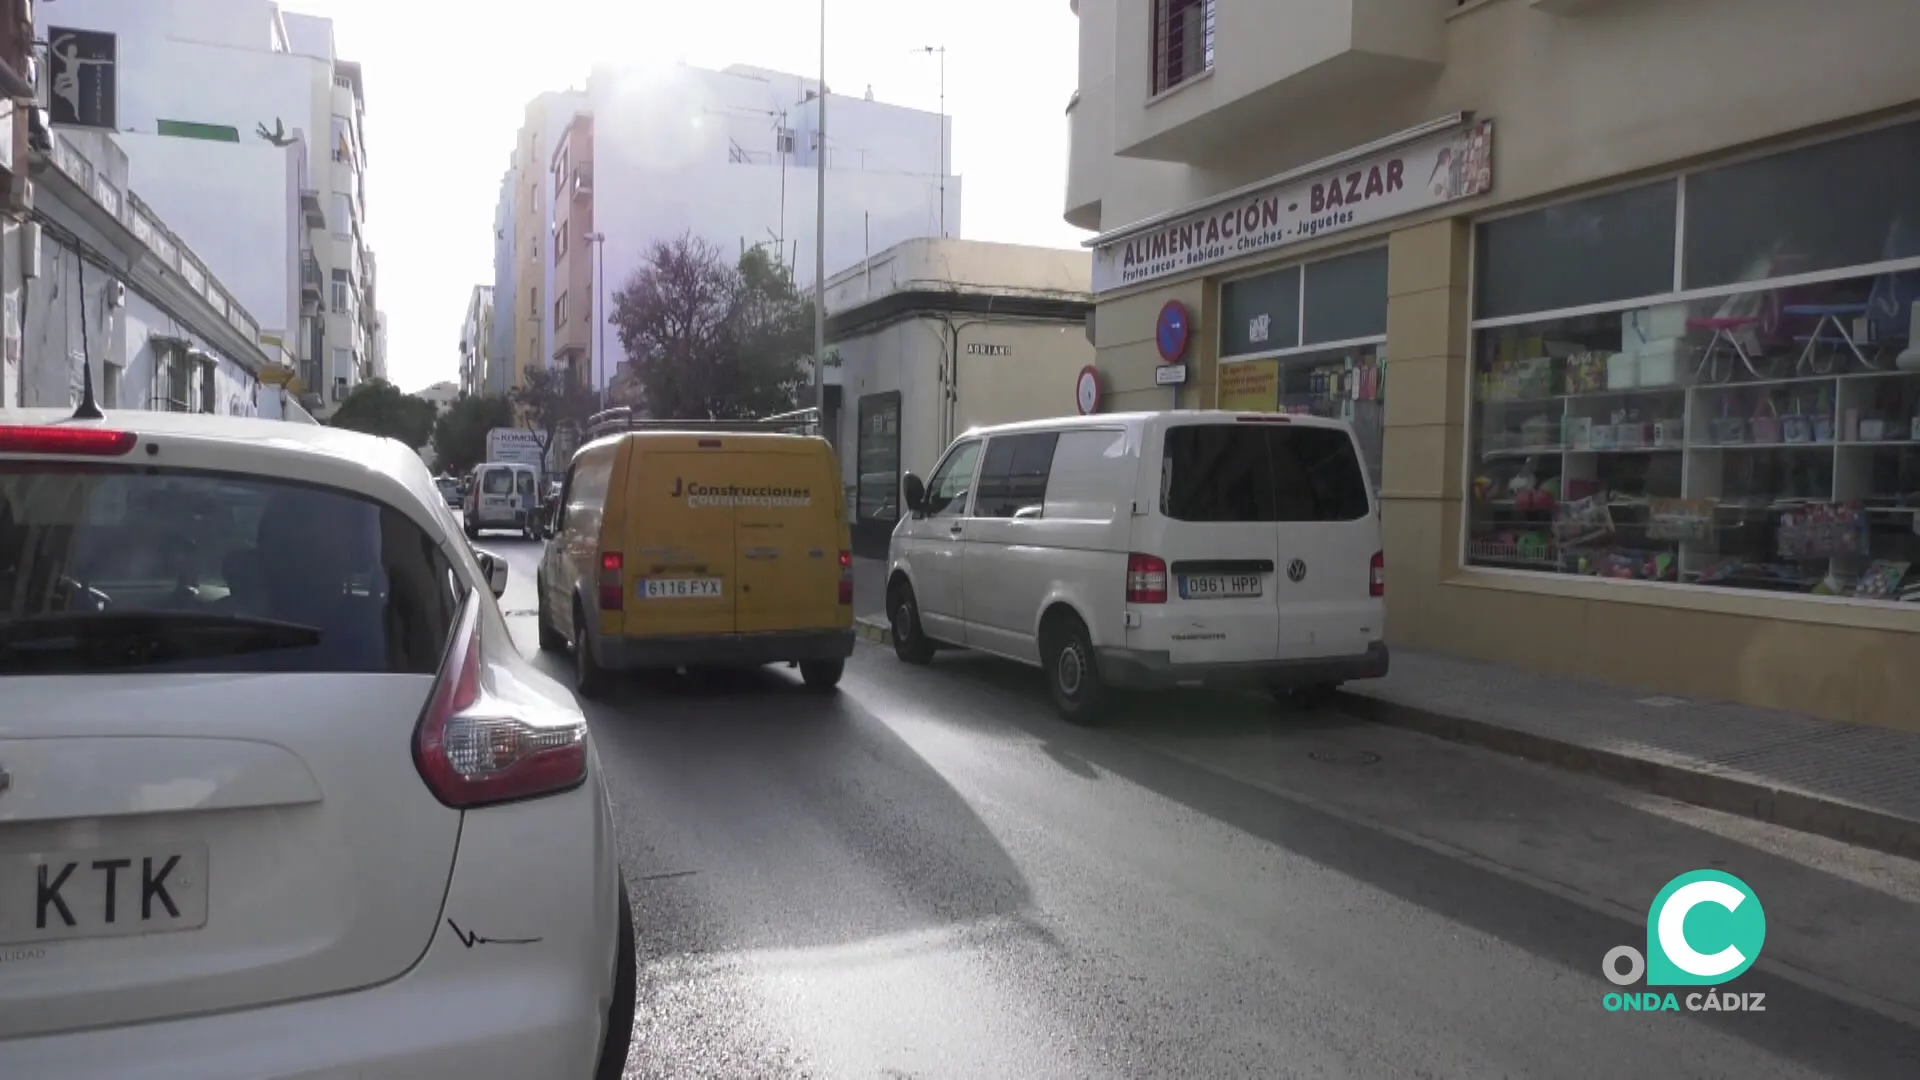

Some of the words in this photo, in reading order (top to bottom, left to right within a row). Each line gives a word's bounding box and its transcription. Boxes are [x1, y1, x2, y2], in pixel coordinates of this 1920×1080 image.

[1123, 197, 1279, 268] ALIMENTACIÓN
[1310, 159, 1404, 214] BAZAR
[1122, 266, 1148, 283] Frutos
[1151, 258, 1176, 274] secos
[1187, 245, 1225, 264] Bebidas
[1237, 229, 1282, 251] Chuches
[1297, 211, 1353, 235] Juguetes
[967, 343, 1011, 356] ADRIANO
[671, 476, 683, 497] J
[687, 482, 811, 498] Construcciones
[648, 581, 686, 595] 6116
[690, 580, 718, 594] FYX
[1189, 577, 1226, 593] 0961
[1232, 576, 1258, 592] HPP
[36, 855, 182, 928] KTK
